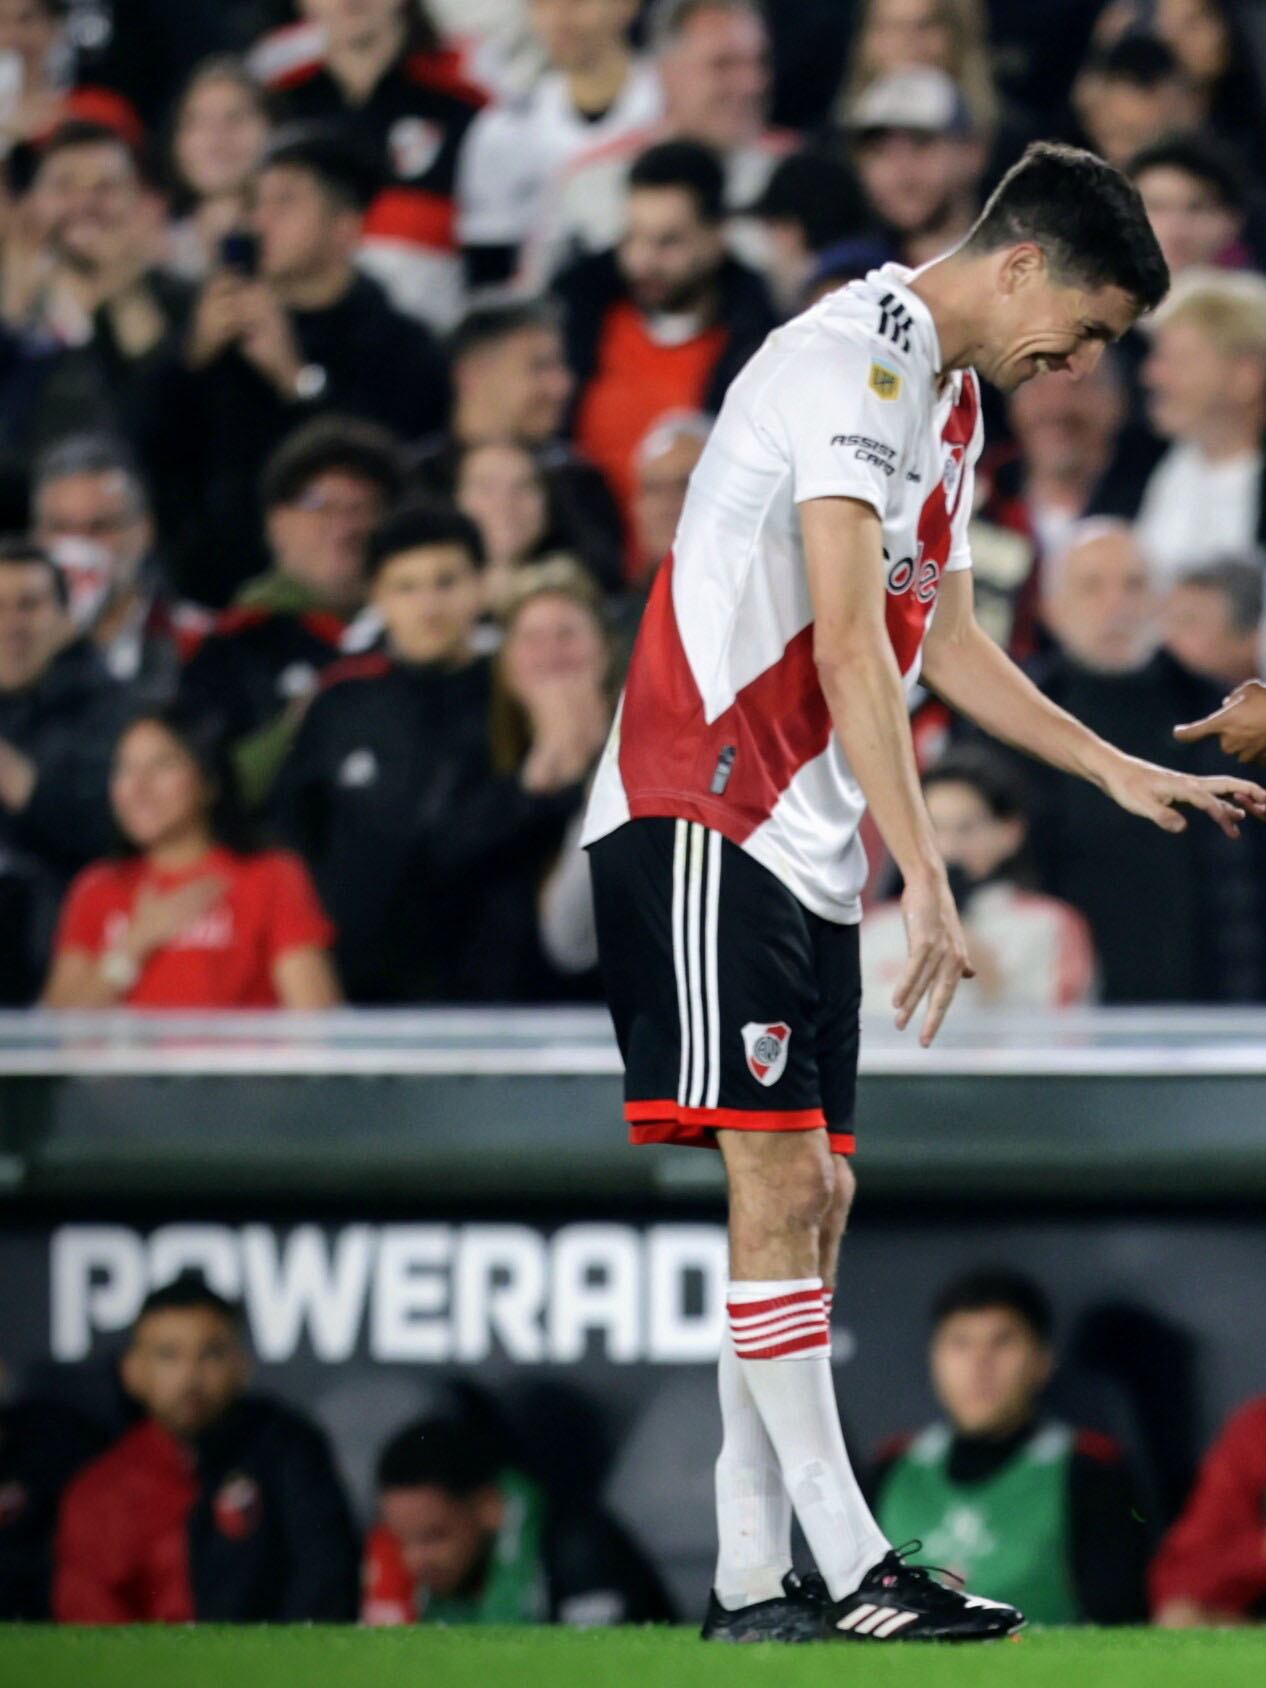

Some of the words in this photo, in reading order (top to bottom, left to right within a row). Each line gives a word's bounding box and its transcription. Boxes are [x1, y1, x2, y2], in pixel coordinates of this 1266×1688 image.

[830, 435, 896, 459] ASSIST
[854, 449, 896, 476] CARD
[51, 1223, 730, 1363] POWERAD
